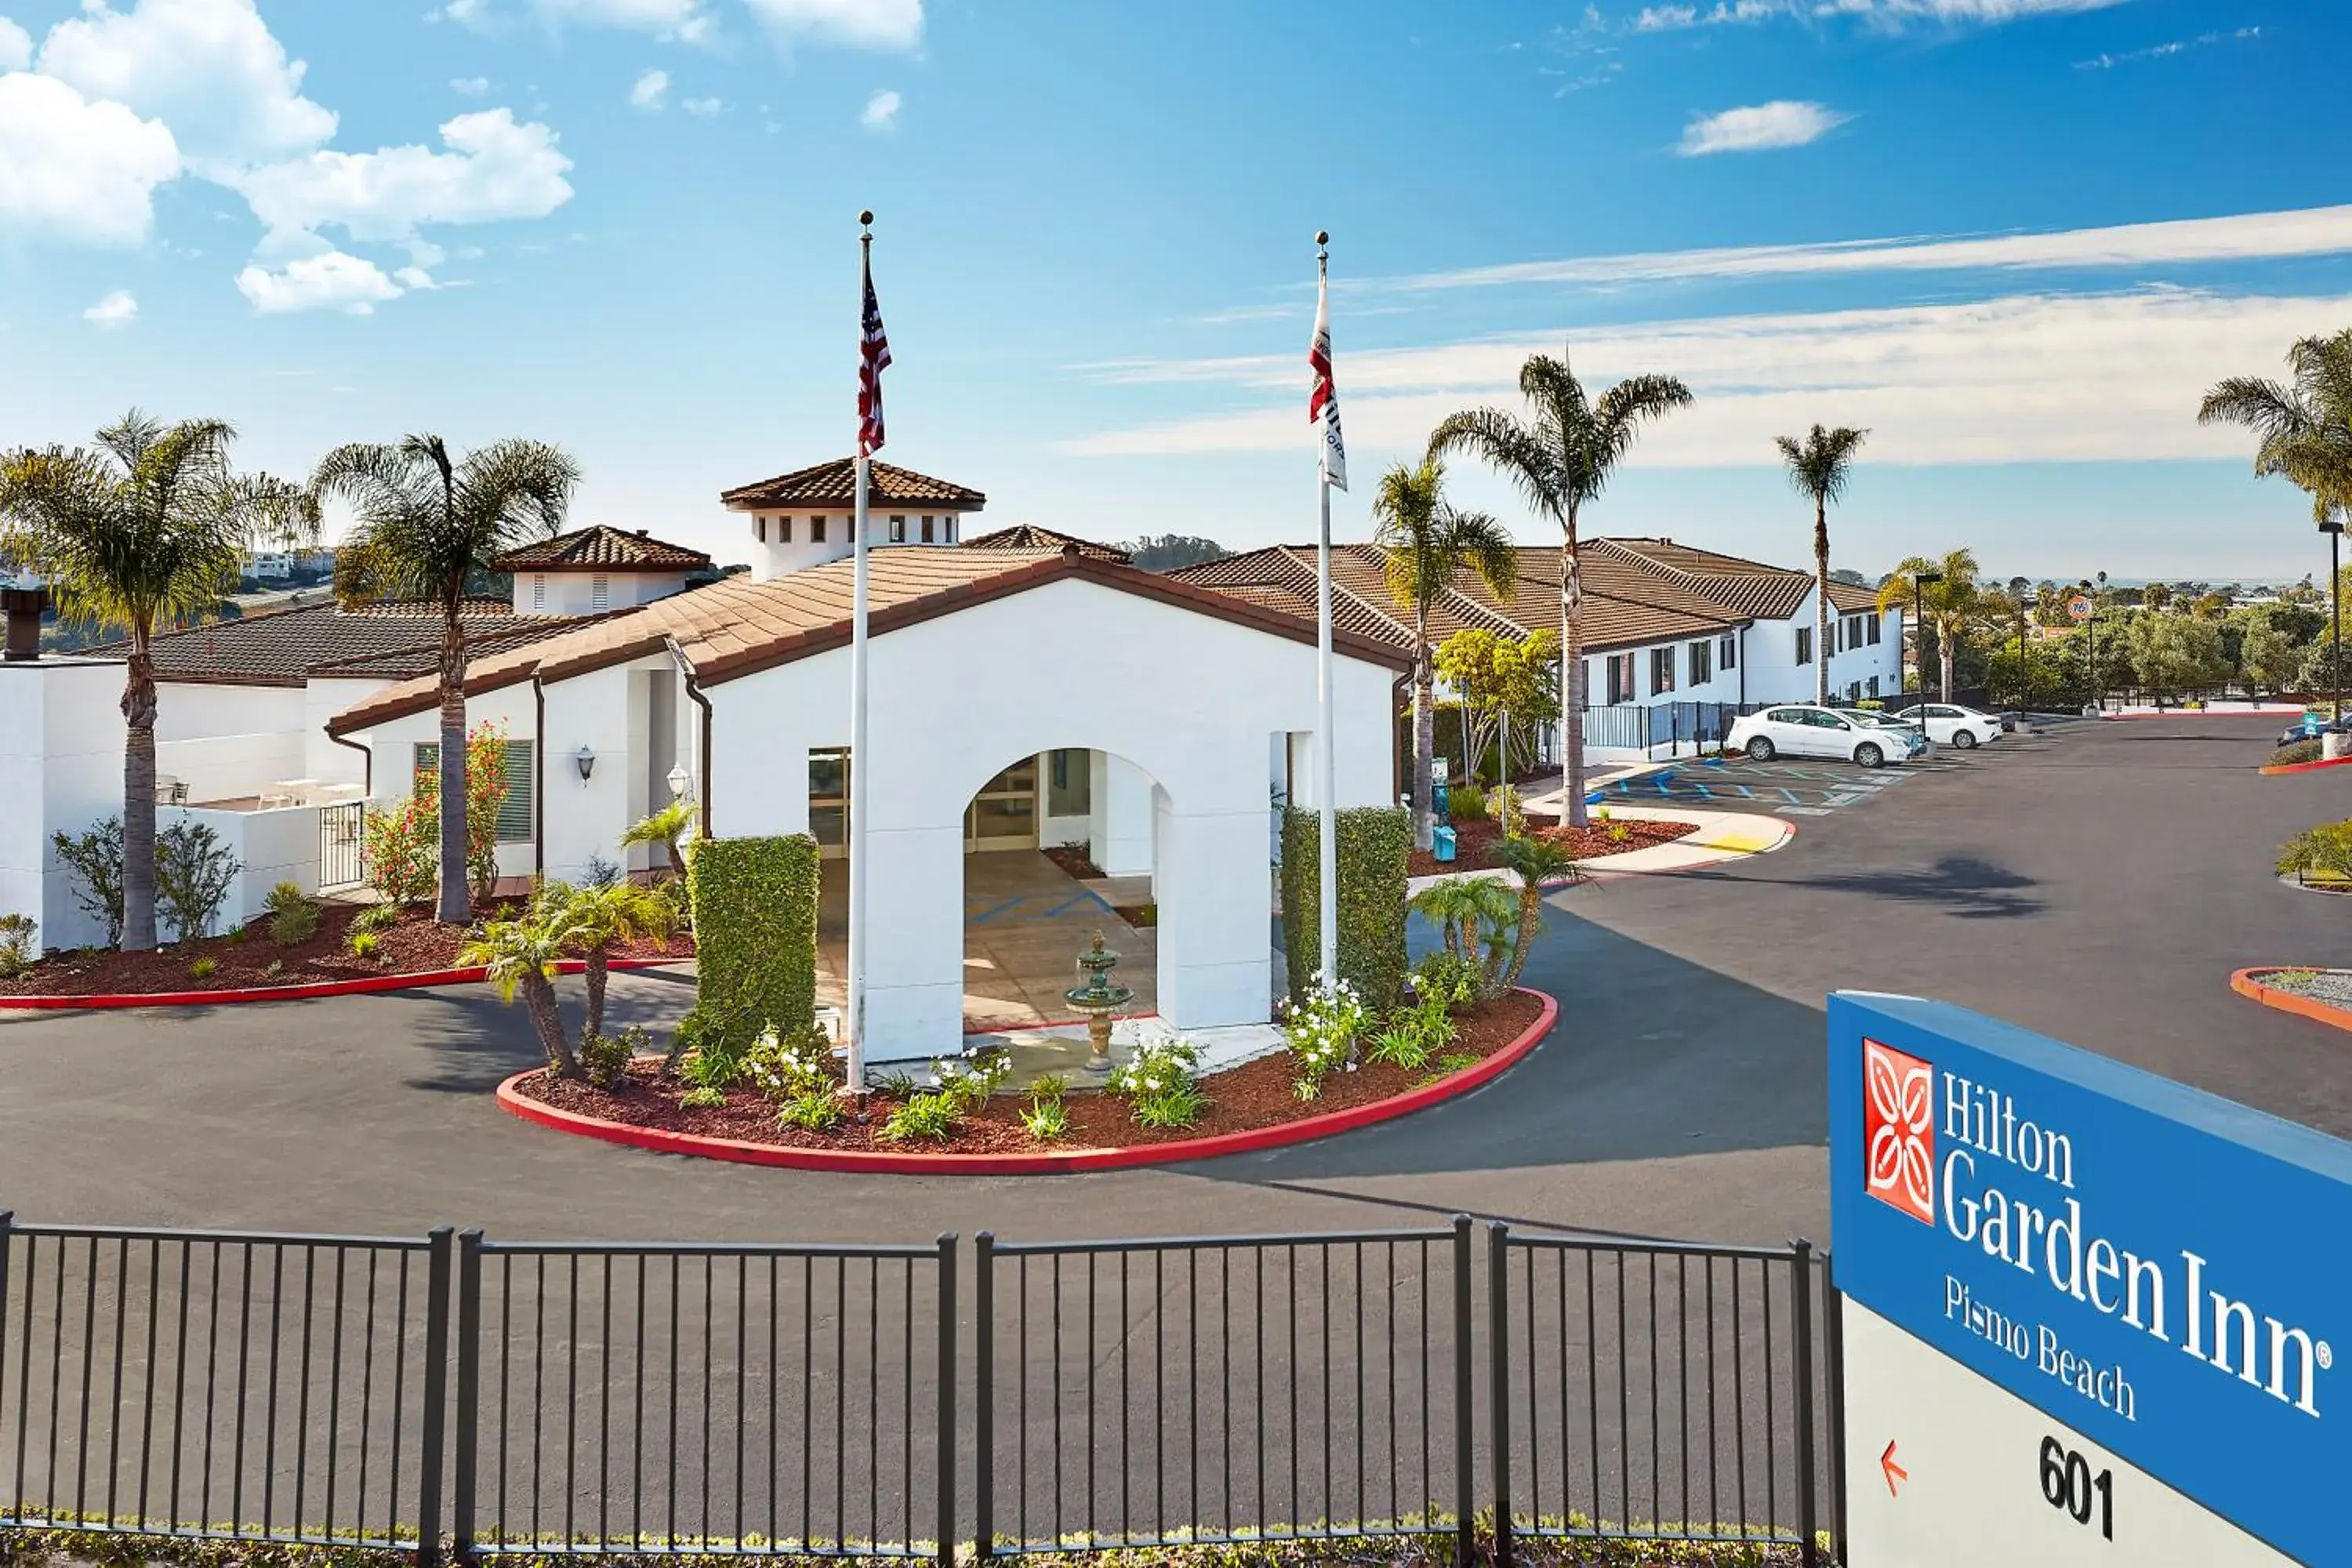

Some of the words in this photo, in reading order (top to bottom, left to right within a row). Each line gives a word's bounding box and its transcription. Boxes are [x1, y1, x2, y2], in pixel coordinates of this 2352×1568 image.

[1942, 1072, 2076, 1189] Hilton
[1943, 1149, 2170, 1341] Garden
[1944, 1275, 2030, 1359] Pismo
[2037, 1324, 2136, 1421] Beach
[2039, 1435, 2114, 1542] 601
